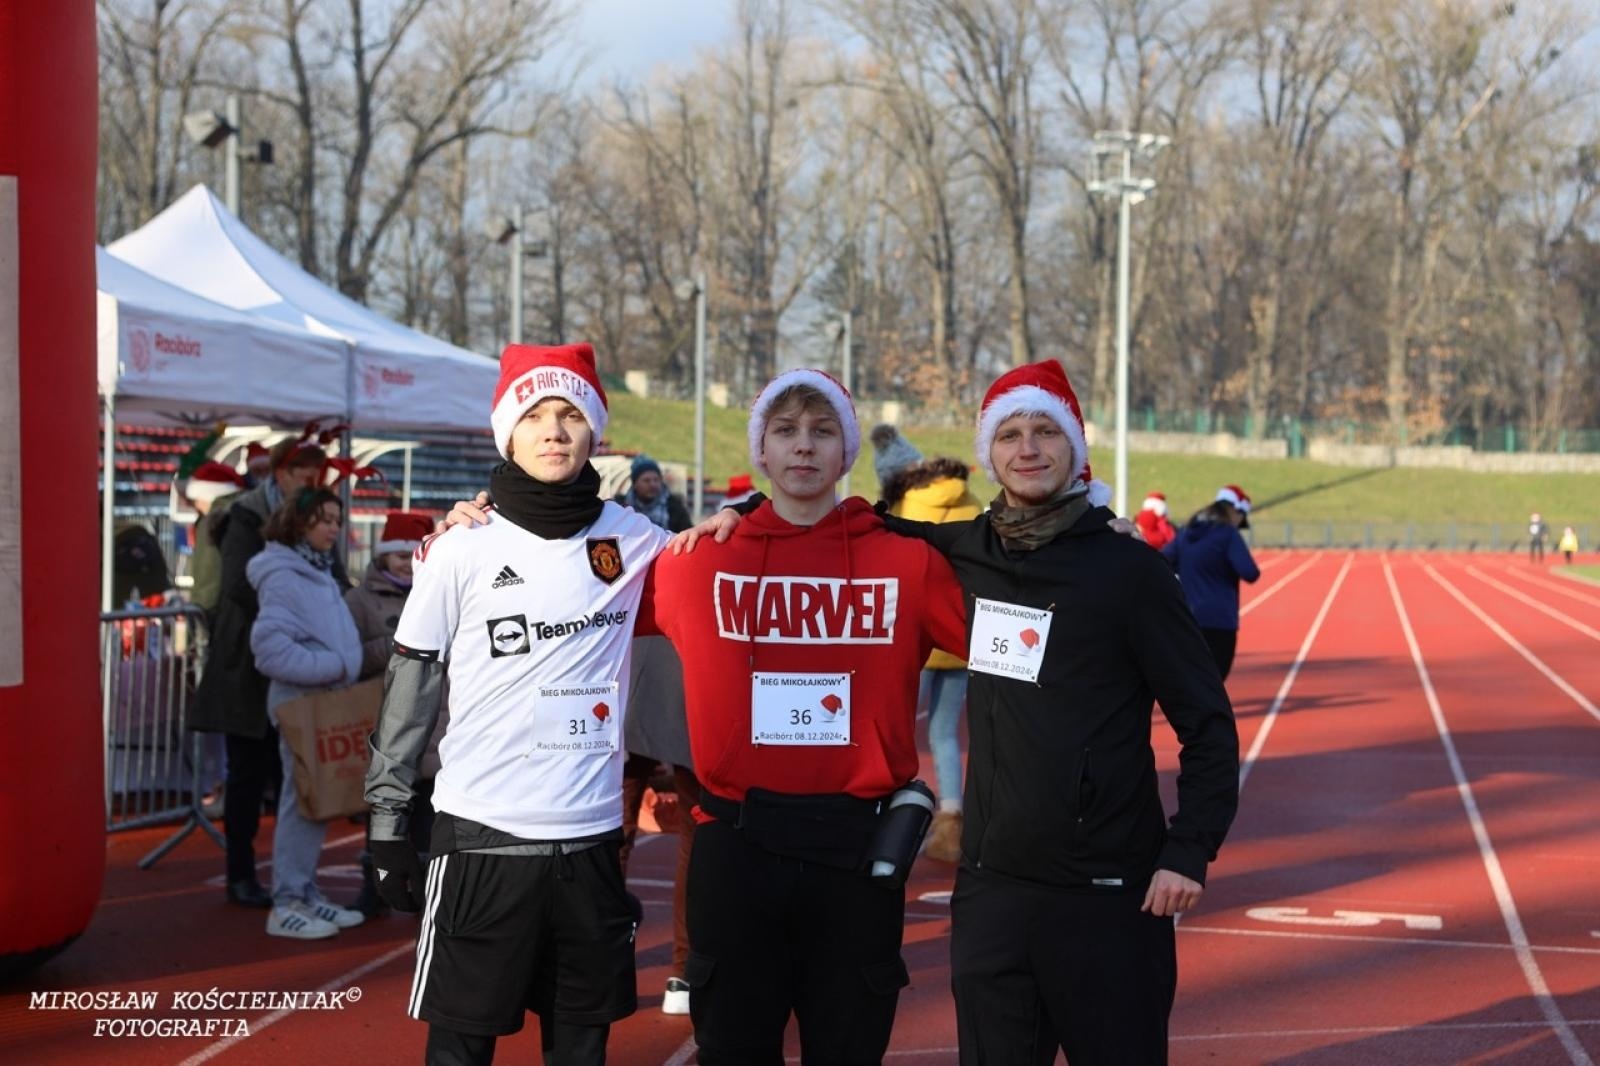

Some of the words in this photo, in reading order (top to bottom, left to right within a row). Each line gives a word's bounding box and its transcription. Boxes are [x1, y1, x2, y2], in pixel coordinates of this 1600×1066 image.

[491, 577, 525, 589] adidas
[719, 581, 889, 638] MARVEL
[990, 636, 1009, 655] 56
[760, 678, 779, 686] BIEG
[780, 678, 842, 687] MIKOŁAJKOWY
[540, 689, 560, 697] BIEG
[560, 687, 611, 697] MIKOŁAJKOWY
[789, 709, 812, 726] 36
[569, 719, 588, 736] 31
